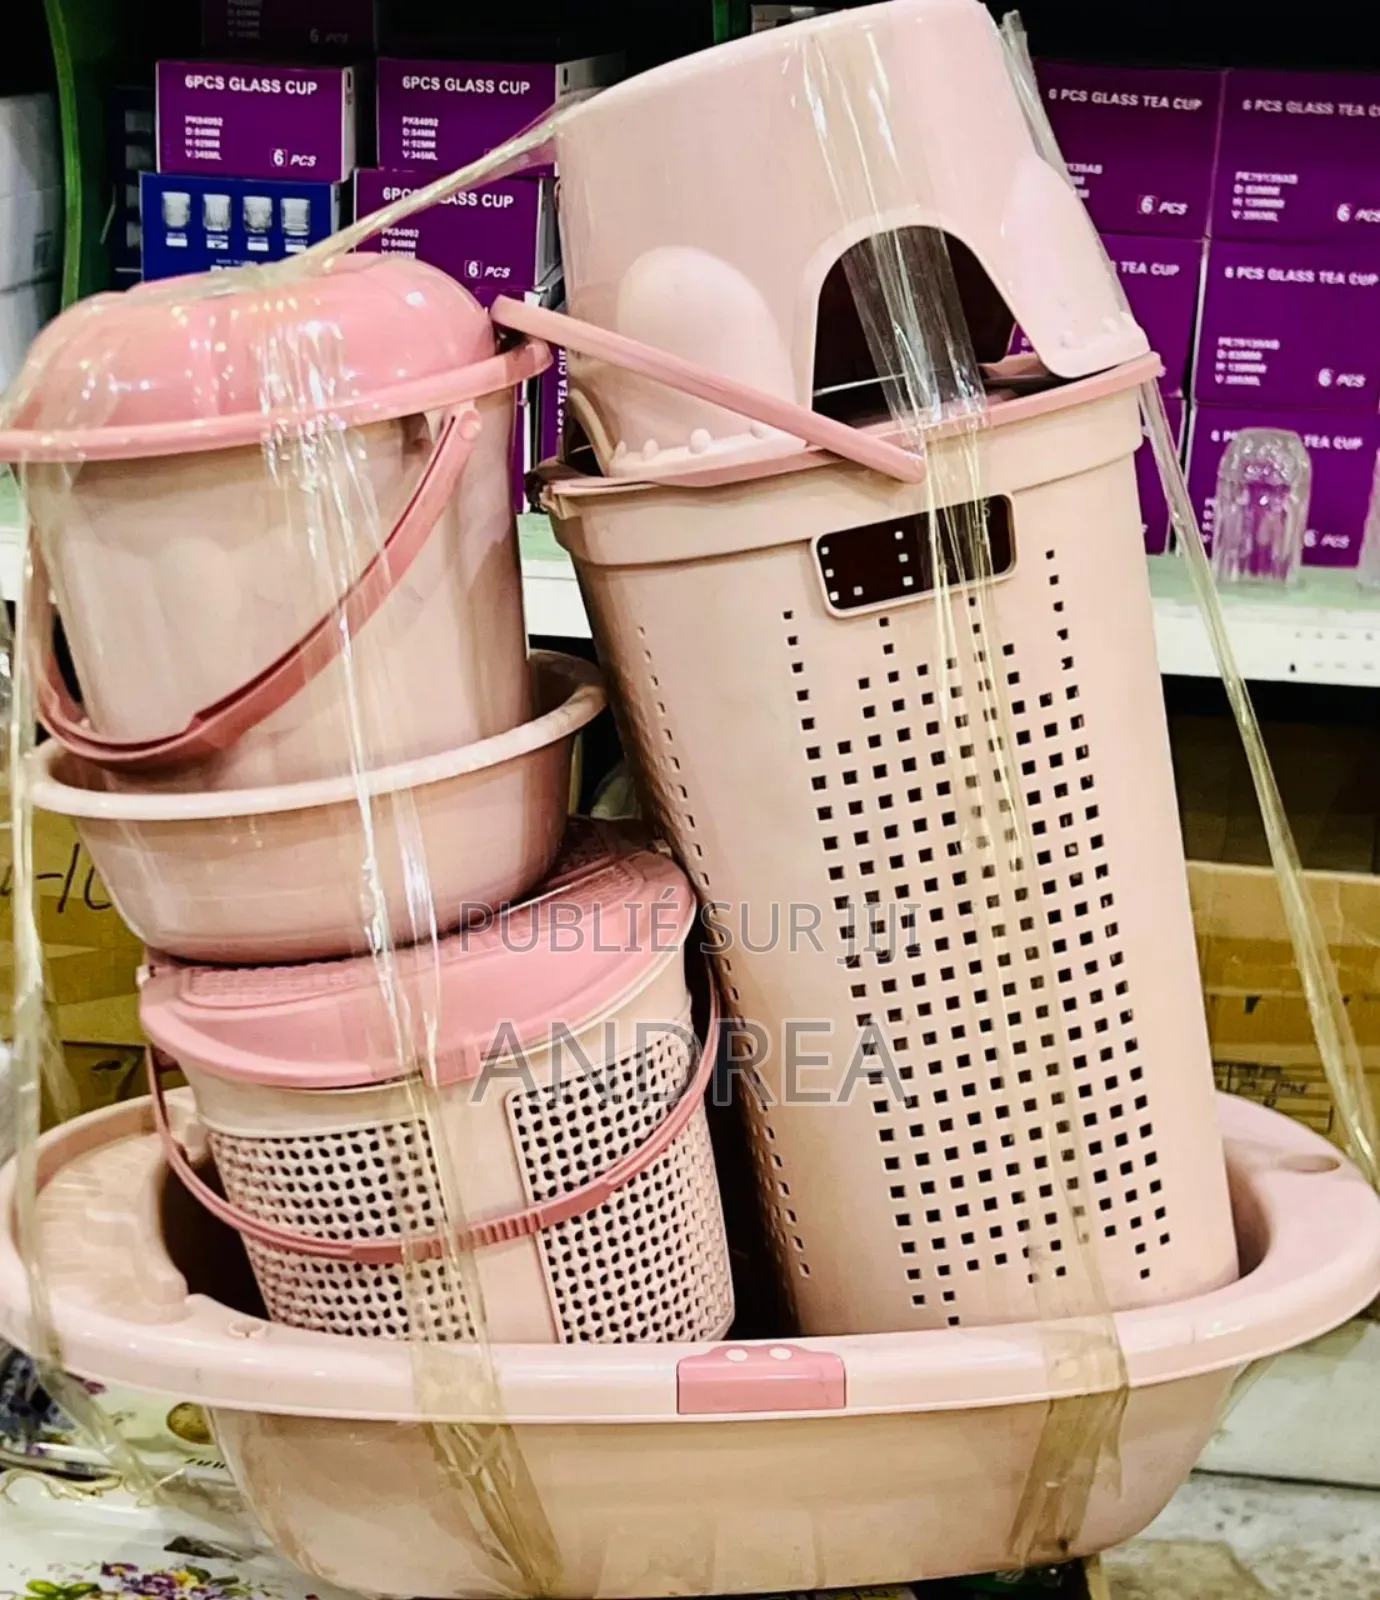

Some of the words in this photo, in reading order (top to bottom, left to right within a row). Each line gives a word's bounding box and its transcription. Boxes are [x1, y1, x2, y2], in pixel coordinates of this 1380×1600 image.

[185, 75, 225, 90] 6PCS
[229, 77, 281, 93] GLASS
[285, 80, 318, 95] CUP
[402, 75, 441, 90] 6PCS
[444, 78, 495, 94] GLASS
[499, 80, 530, 95] CUP
[1061, 89, 1088, 102] PCS
[1091, 90, 1138, 106] GLASS
[1143, 95, 1170, 109] TEA
[1173, 97, 1203, 111] CUP
[1255, 100, 1282, 113] PCS
[1285, 101, 1334, 116] GLASS
[1338, 103, 1365, 117] TEA
[273, 149, 284, 166] 6
[290, 154, 317, 167] PCS
[482, 193, 514, 208] CUP
[1141, 196, 1154, 214] 6
[1159, 202, 1189, 216] PCS
[1336, 203, 1351, 222] 6
[467, 261, 478, 277] 6
[484, 266, 511, 279] PCS
[1121, 261, 1148, 275] TEA
[1151, 263, 1181, 277] CUP
[1237, 266, 1265, 281] PCS
[1268, 268, 1315, 284] GLASS
[1319, 271, 1345, 285] TEA
[1349, 273, 1379, 287] CUP
[1318, 368, 1333, 388] 6
[1336, 373, 1366, 388] PCS
[1303, 434, 1331, 449] TEA
[1333, 436, 1364, 450] CUP
[1304, 529, 1318, 548] 6
[1320, 534, 1350, 549] PCS
